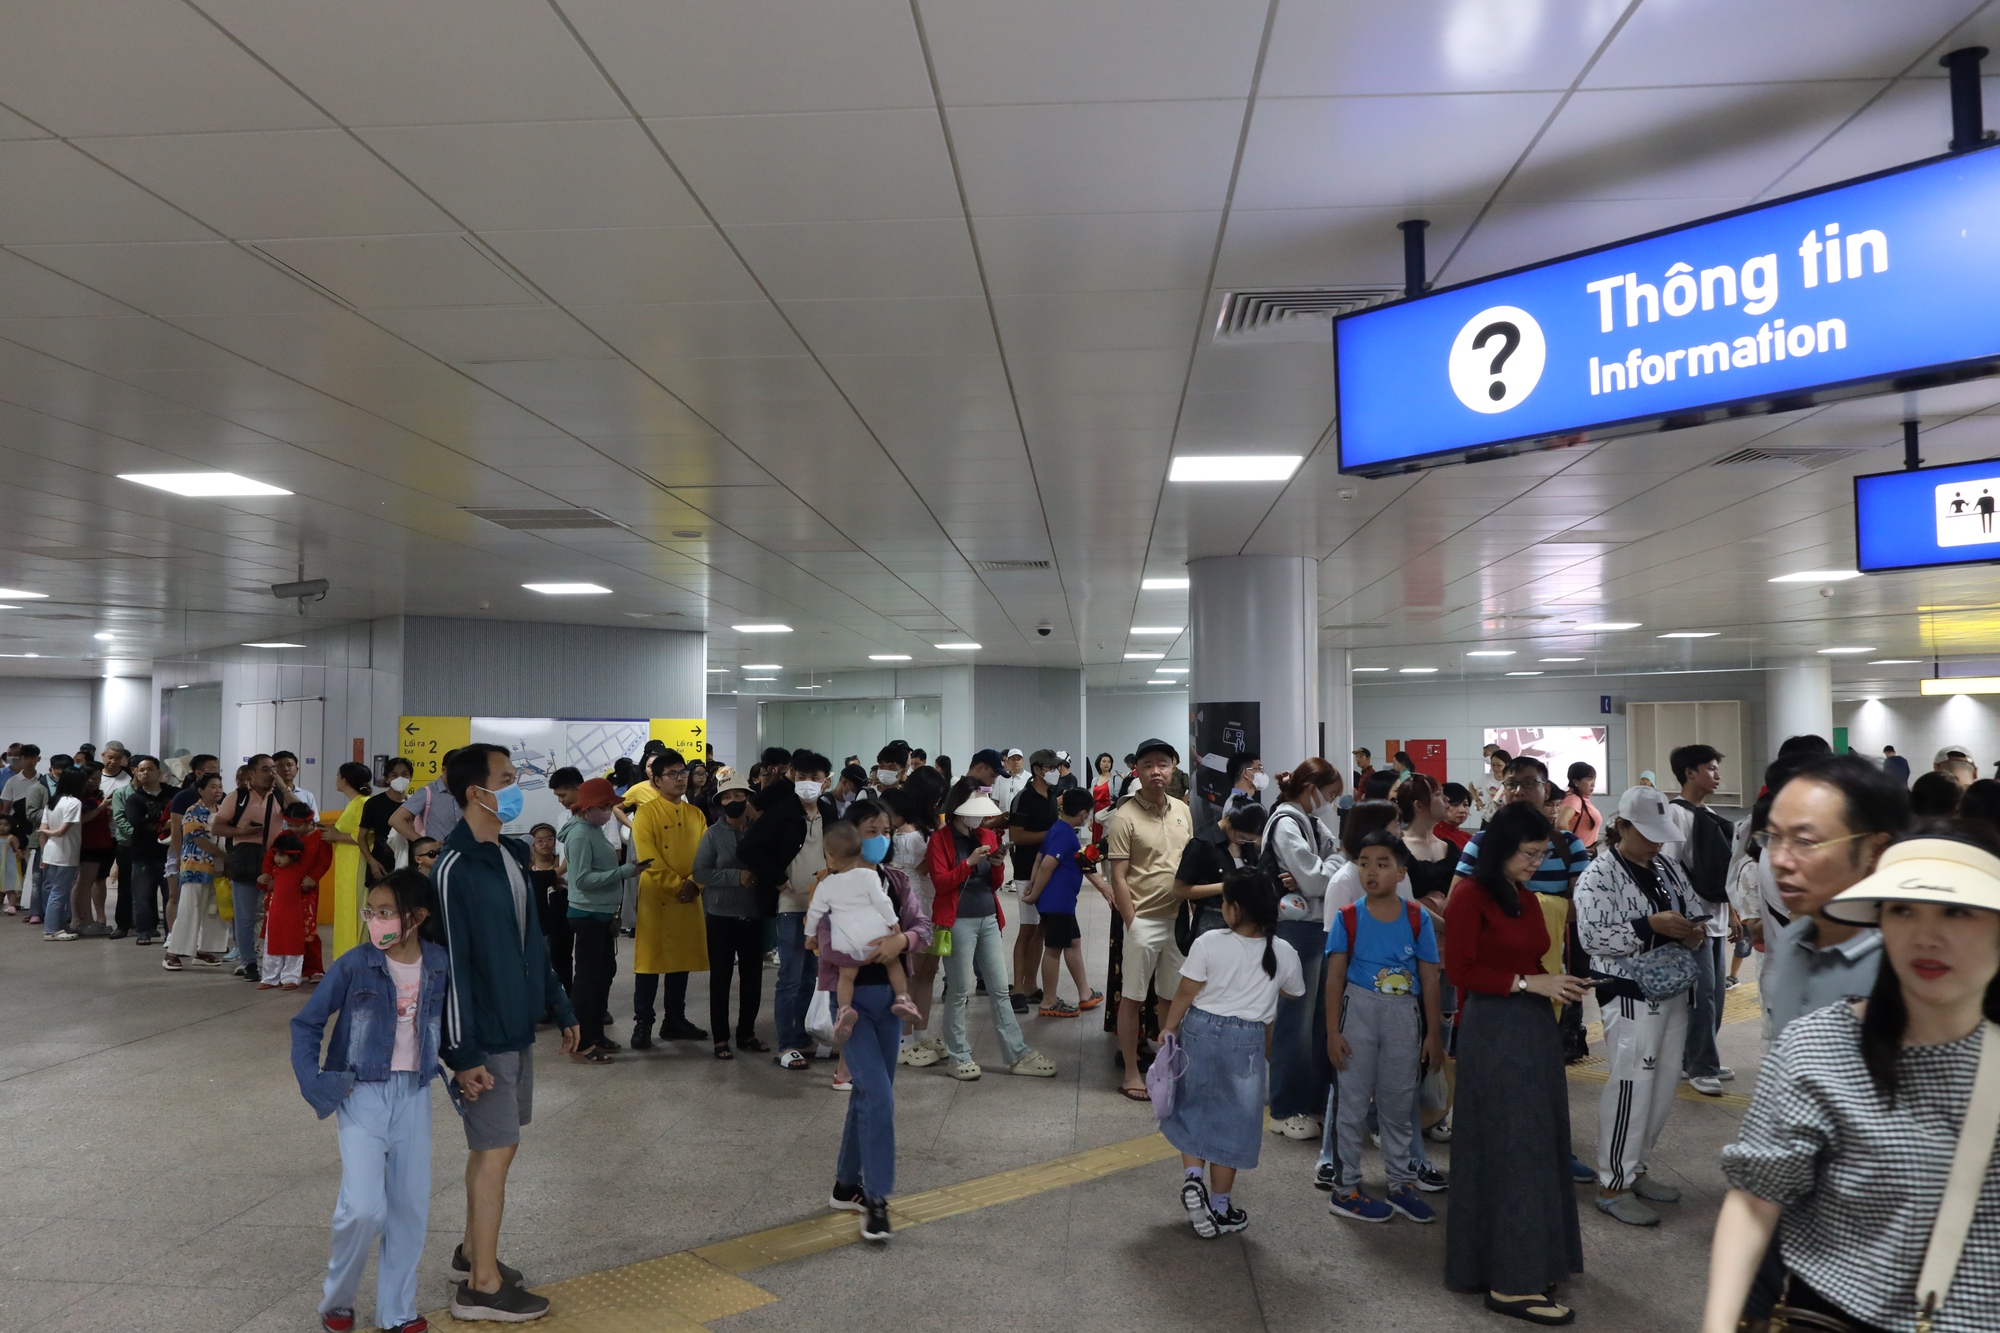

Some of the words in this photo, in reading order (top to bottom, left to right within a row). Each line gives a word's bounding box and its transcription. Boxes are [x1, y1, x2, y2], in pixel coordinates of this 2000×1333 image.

[1587, 253, 1779, 333] Thông
[1798, 222, 1889, 289] tin
[1471, 320, 1522, 402] ?
[1590, 319, 1847, 396] Information
[428, 760, 437, 774] 3
[429, 740, 437, 753] 2
[696, 741, 702, 752] 5
